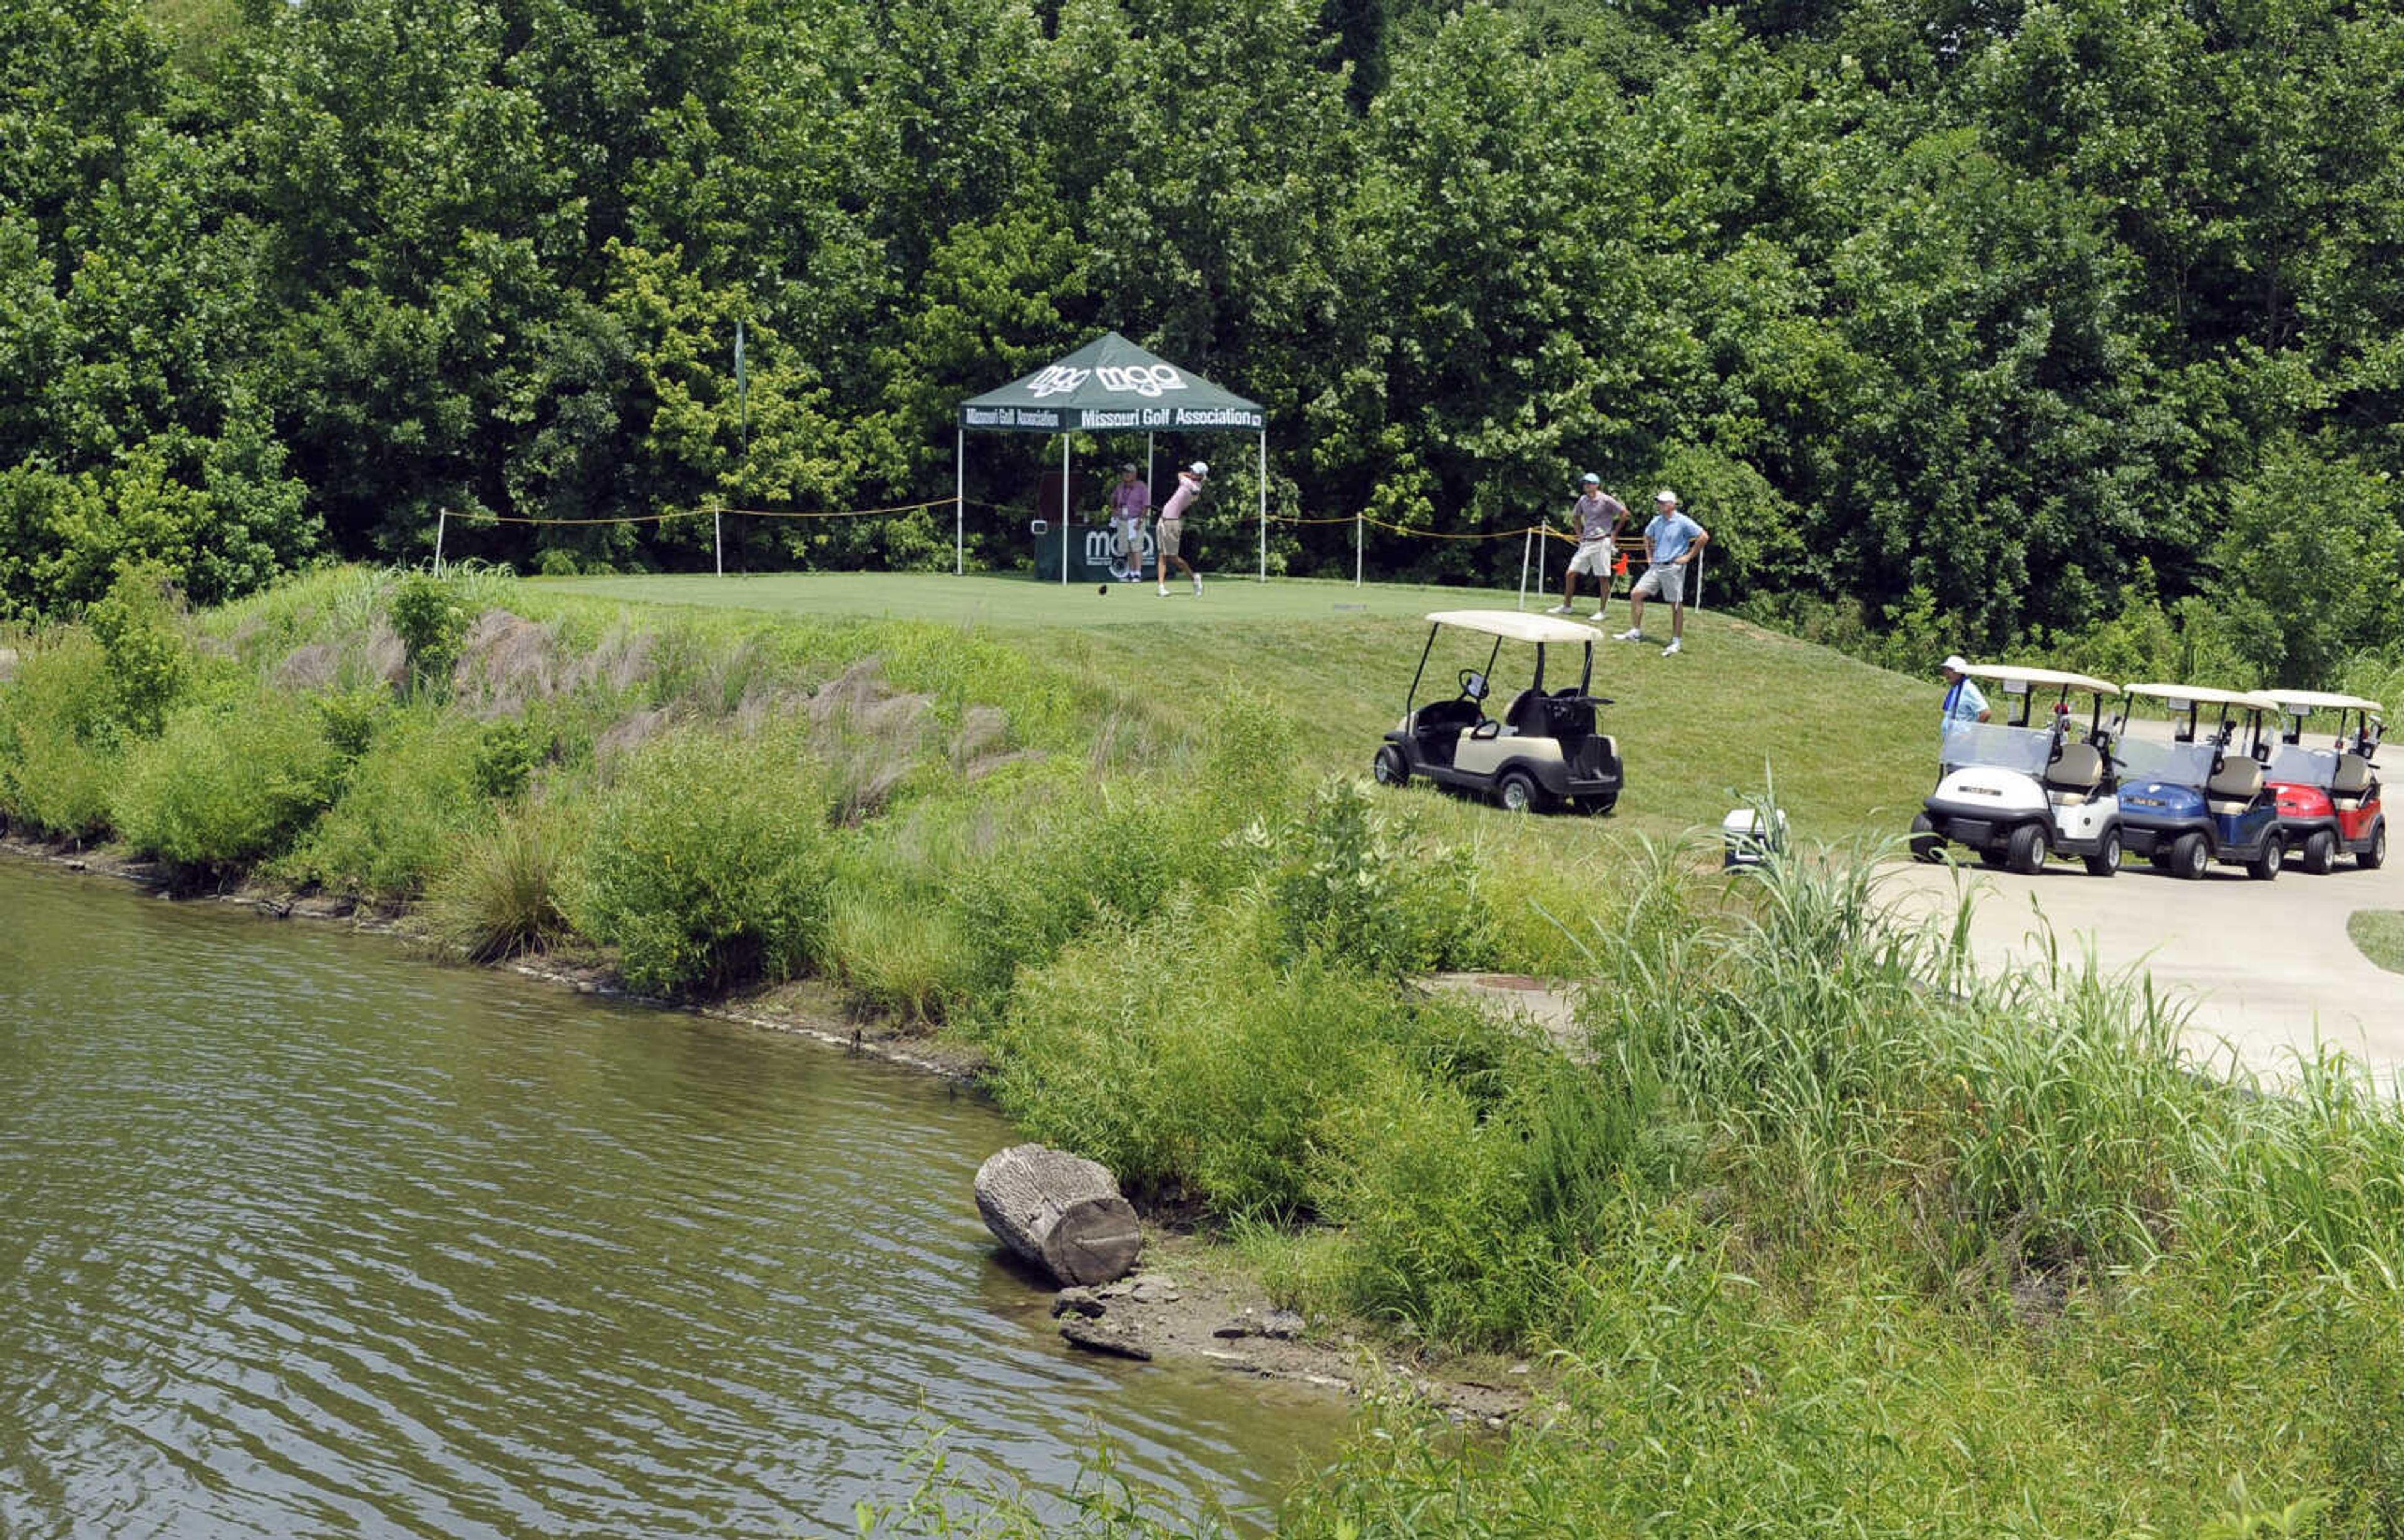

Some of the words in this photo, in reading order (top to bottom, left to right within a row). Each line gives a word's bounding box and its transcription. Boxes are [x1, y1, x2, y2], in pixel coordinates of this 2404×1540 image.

[1096, 364, 1188, 397] mga
[1082, 409, 1139, 427] Missouri
[1143, 408, 1169, 425] Golf
[1175, 408, 1250, 425] Association
